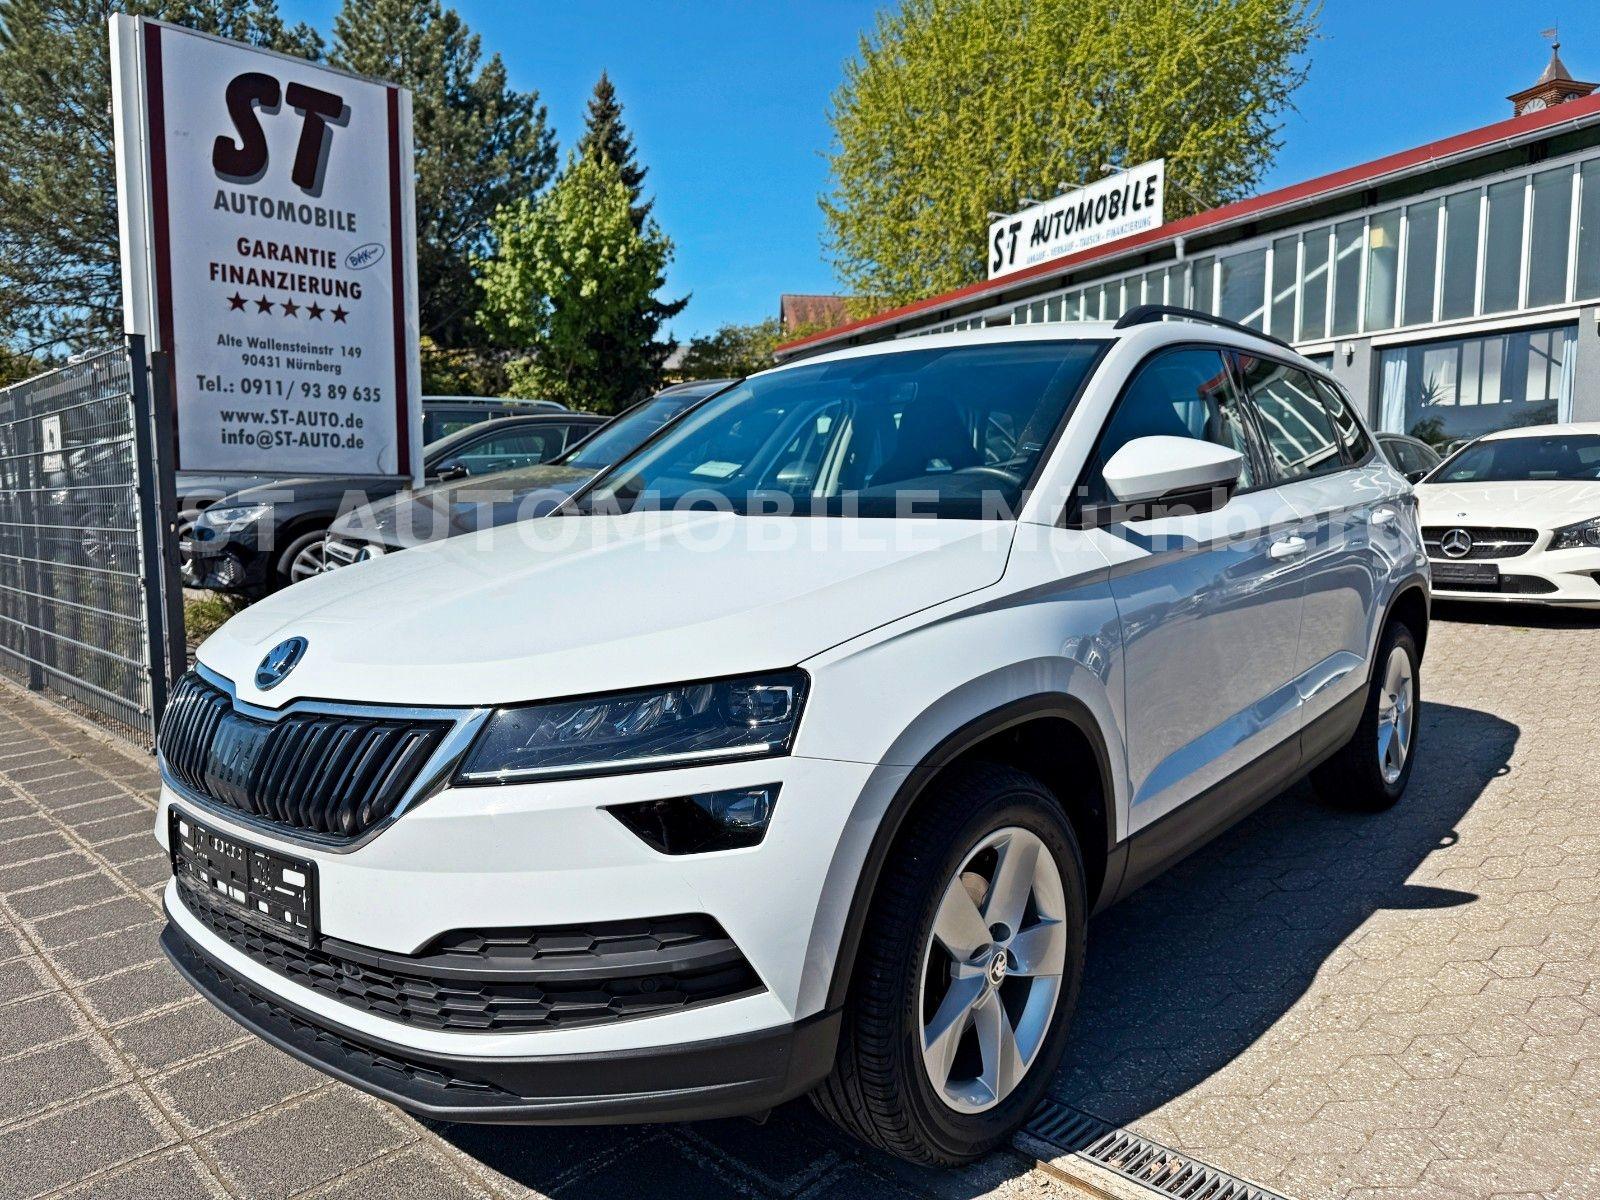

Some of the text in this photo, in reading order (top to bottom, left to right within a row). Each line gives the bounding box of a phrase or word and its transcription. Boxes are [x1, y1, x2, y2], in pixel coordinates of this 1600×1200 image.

[212, 71, 351, 198] ST
[213, 189, 357, 233] AUTOMOBILE
[1030, 174, 1158, 247] AUTOMOBILE
[236, 237, 337, 269] GARANTIE
[209, 262, 362, 300] FINANZIERUNG
[217, 333, 362, 358] Alte Wallensteinstr 149
[242, 353, 342, 376] 90431 Nürnberg
[196, 374, 235, 394] Tel.:
[301, 381, 321, 399] 93
[328, 383, 347, 401] 89
[353, 386, 381, 402] 635
[220, 408, 364, 429] www.ST-AUTO.de
[221, 428, 364, 449] info@ST-AUTO.de
